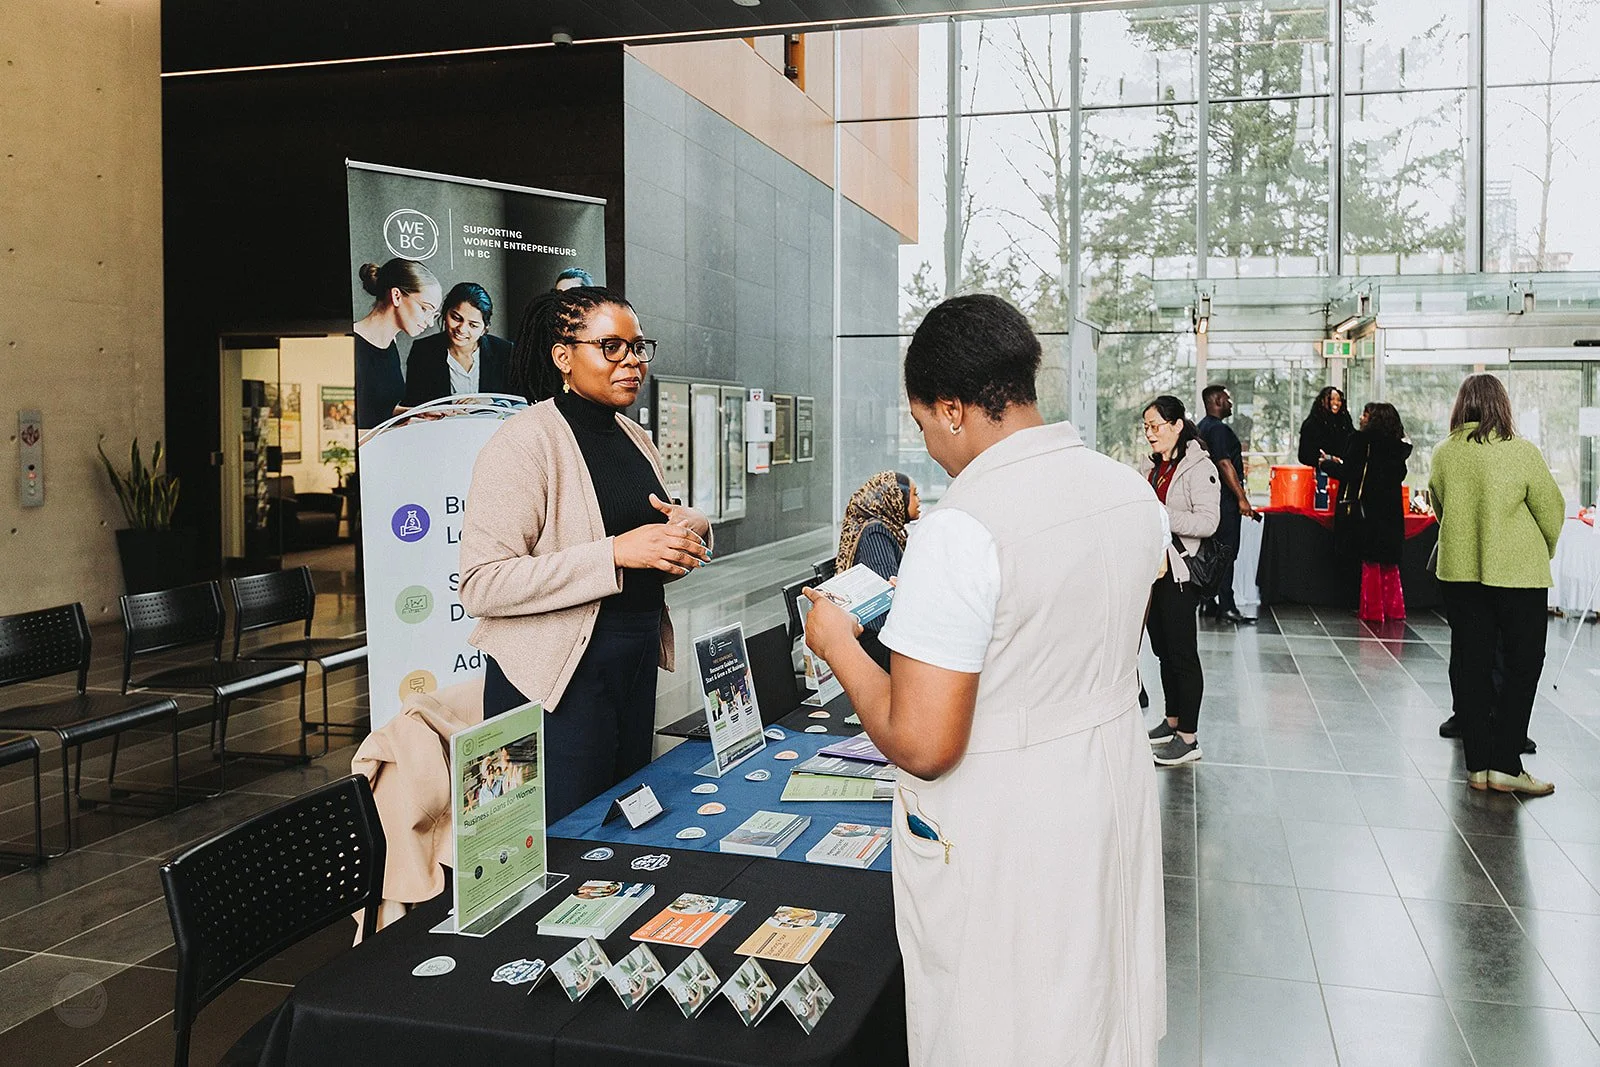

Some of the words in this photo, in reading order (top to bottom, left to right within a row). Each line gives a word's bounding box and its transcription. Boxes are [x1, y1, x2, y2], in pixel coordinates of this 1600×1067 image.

[397, 219, 424, 236] WE
[463, 224, 523, 239] SUPPORTING
[400, 234, 425, 250] BC
[463, 237, 501, 248] WOMEN
[503, 241, 577, 257] ENTREPRENEURS
[464, 249, 475, 257] IN
[477, 250, 491, 259] BC
[451, 603, 475, 622] D
[464, 812, 490, 828] Business
[490, 801, 506, 816] Loans
[507, 797, 515, 806] for
[515, 786, 537, 800] Women
